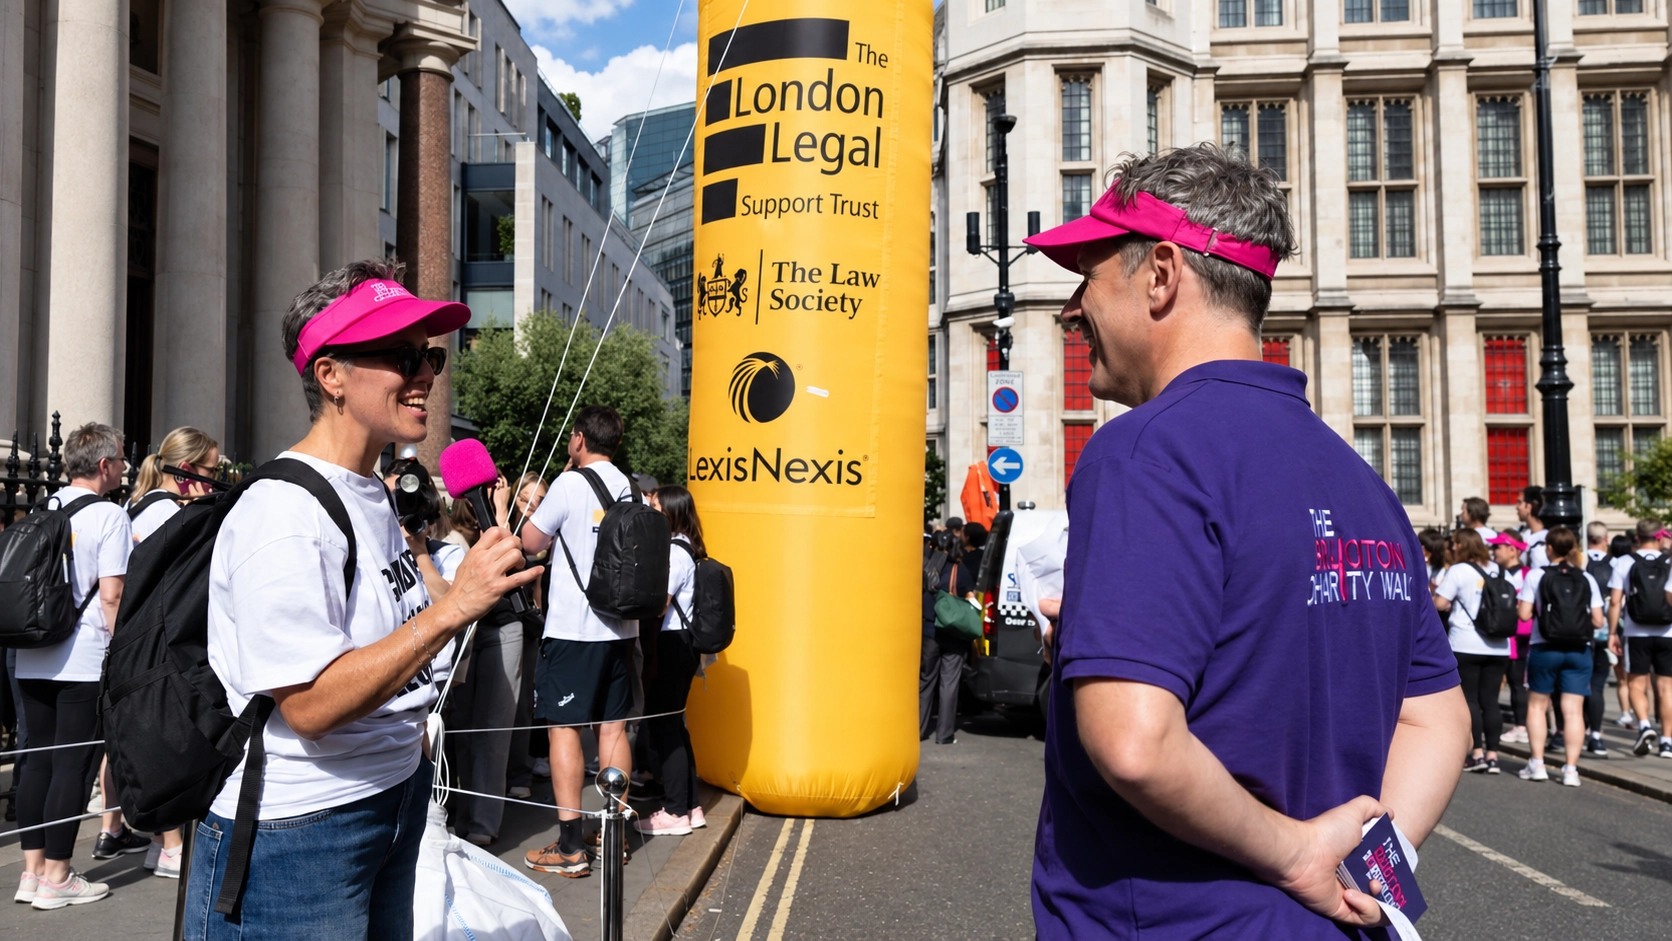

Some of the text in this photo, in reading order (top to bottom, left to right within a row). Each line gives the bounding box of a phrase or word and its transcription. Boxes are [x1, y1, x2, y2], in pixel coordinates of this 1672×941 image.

[855, 42, 888, 68] The
[735, 68, 884, 118] London
[772, 122, 881, 175] Legal
[741, 193, 879, 219] Support Trust
[771, 261, 881, 289] The Law
[769, 288, 863, 319] Society
[689, 446, 863, 486] LexisNexis
[1309, 508, 1335, 537] THE
